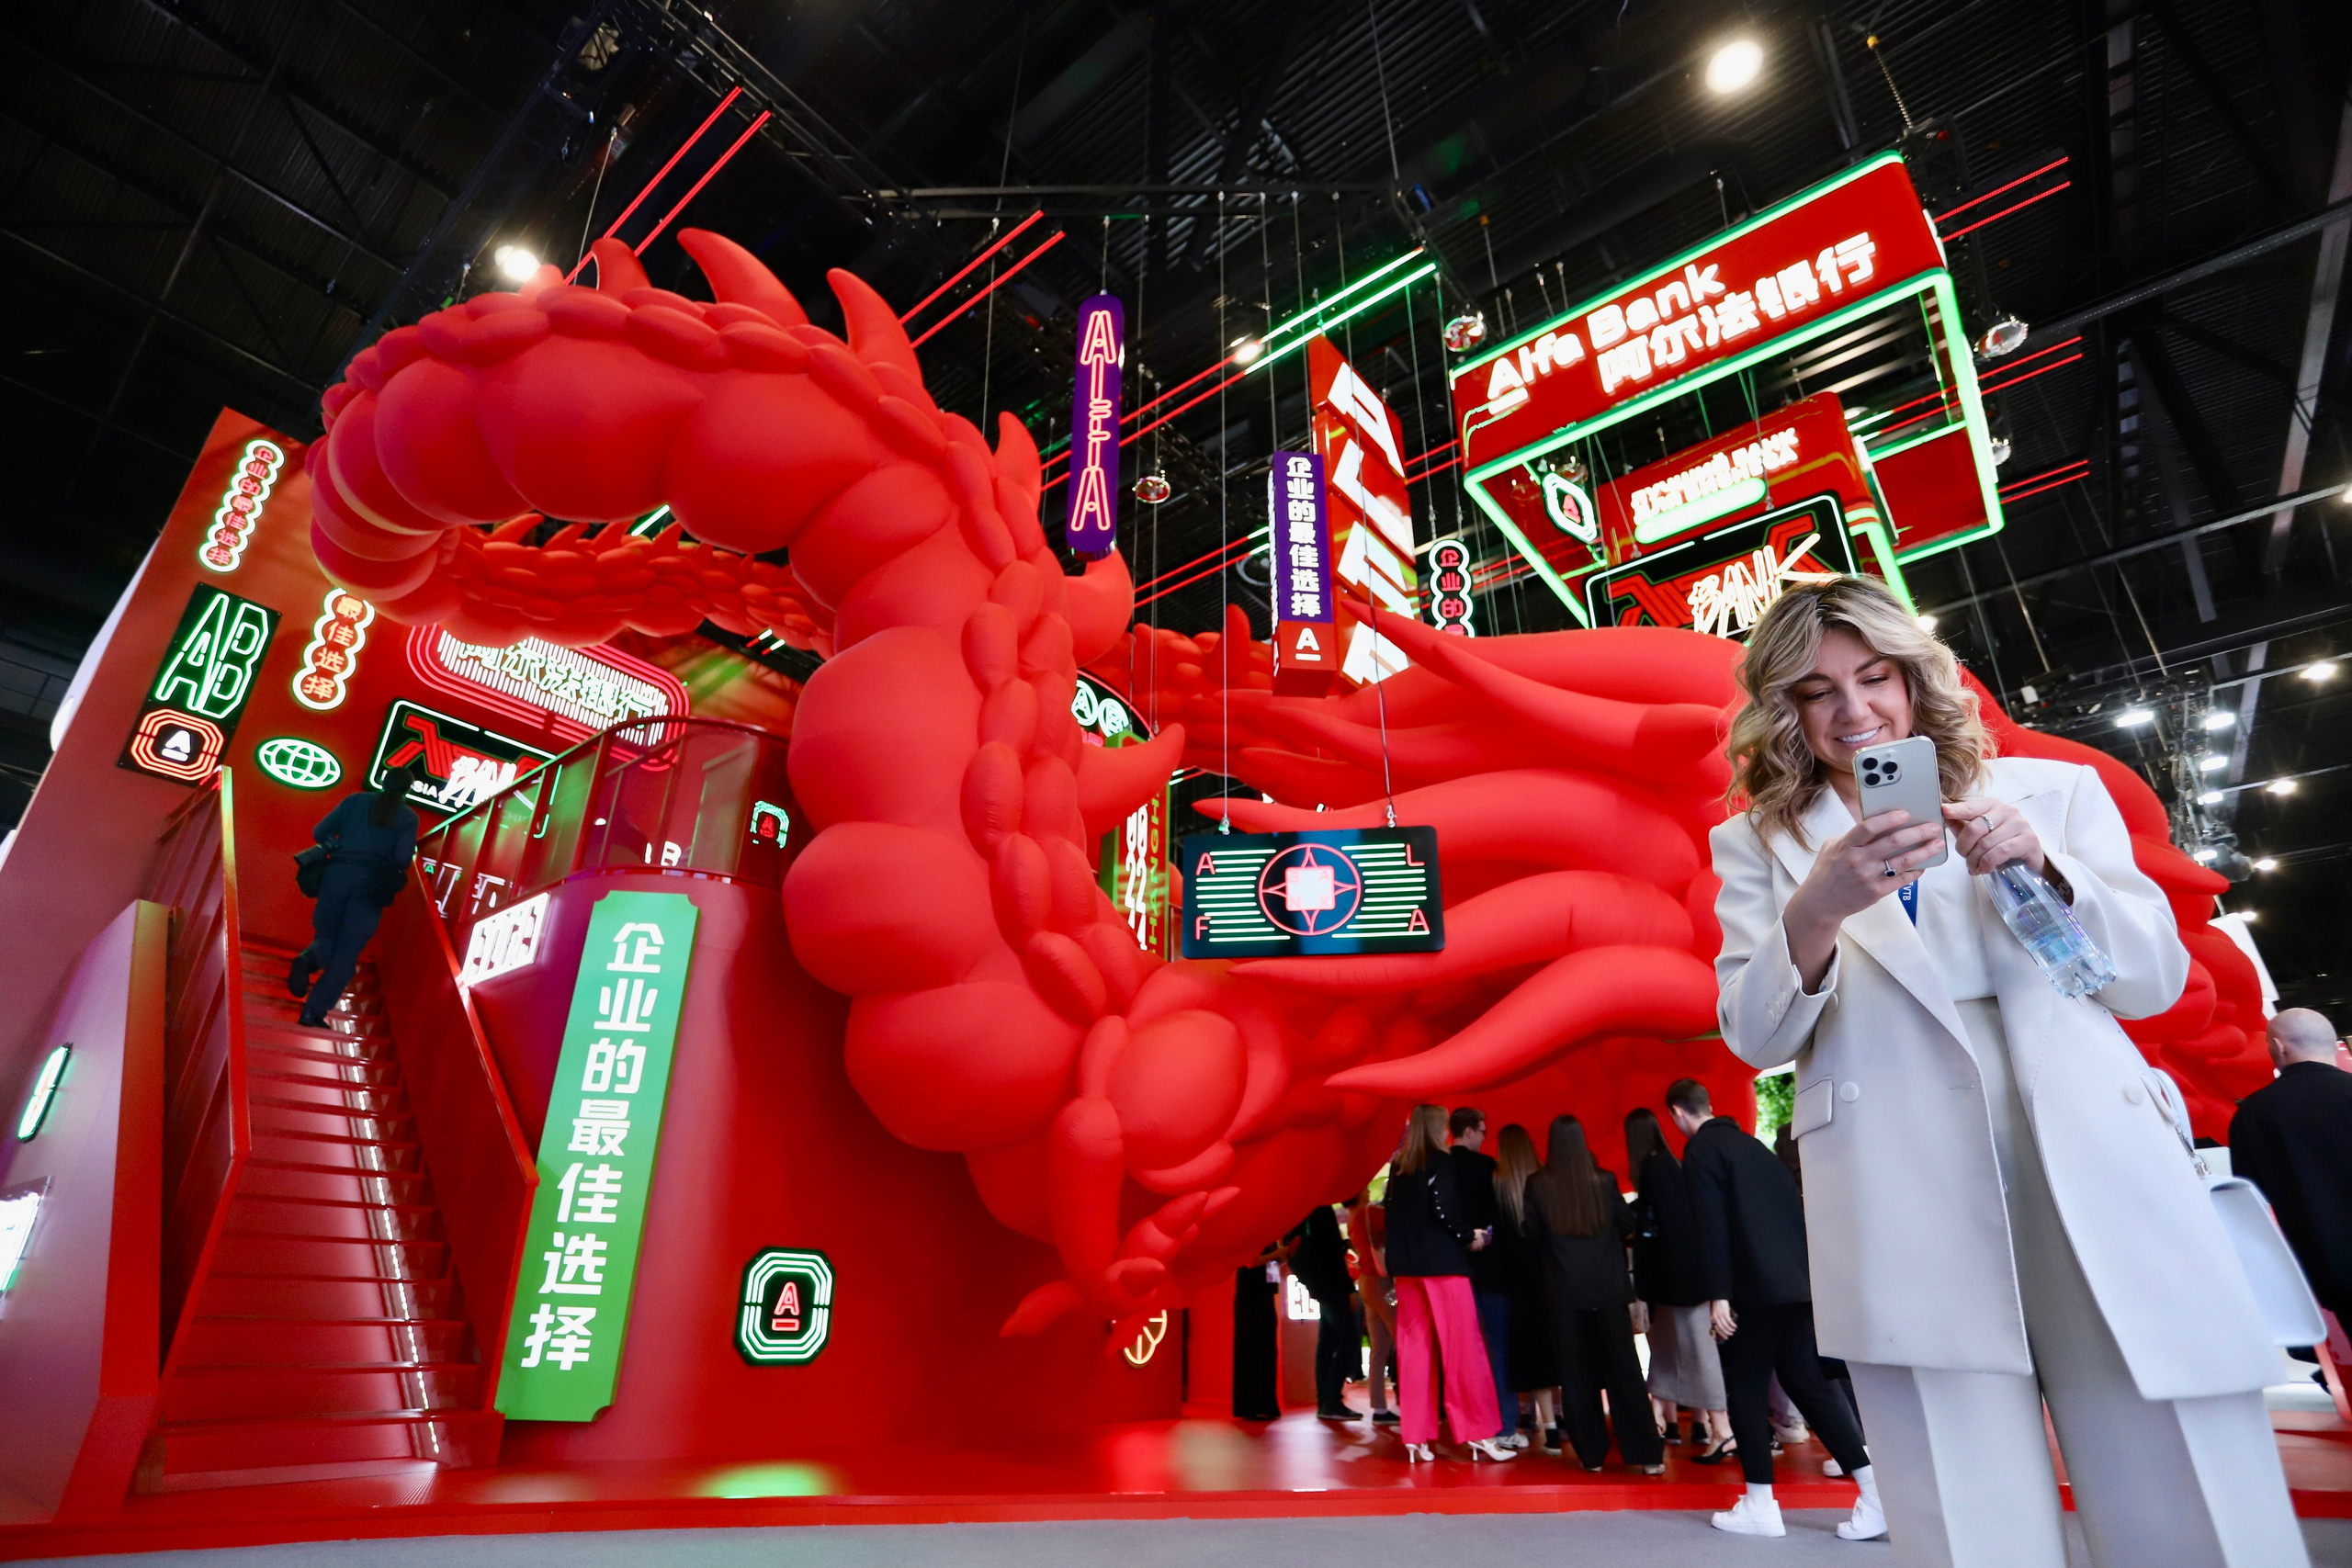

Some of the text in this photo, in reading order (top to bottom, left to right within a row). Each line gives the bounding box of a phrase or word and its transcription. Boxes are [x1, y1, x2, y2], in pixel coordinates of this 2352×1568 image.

[1487, 263, 1726, 402] Alfa Bank
[1596, 231, 1877, 395] 阿尔法银行
[1071, 310, 1117, 532] ALFA
[207, 446, 276, 566] 企业的最佳选择
[1286, 457, 1321, 618] 企业的最佳选择
[301, 594, 365, 701] 最佳选择
[1148, 794, 1160, 954] HANGH
[521, 922, 666, 1371] 企业的最佳选择
